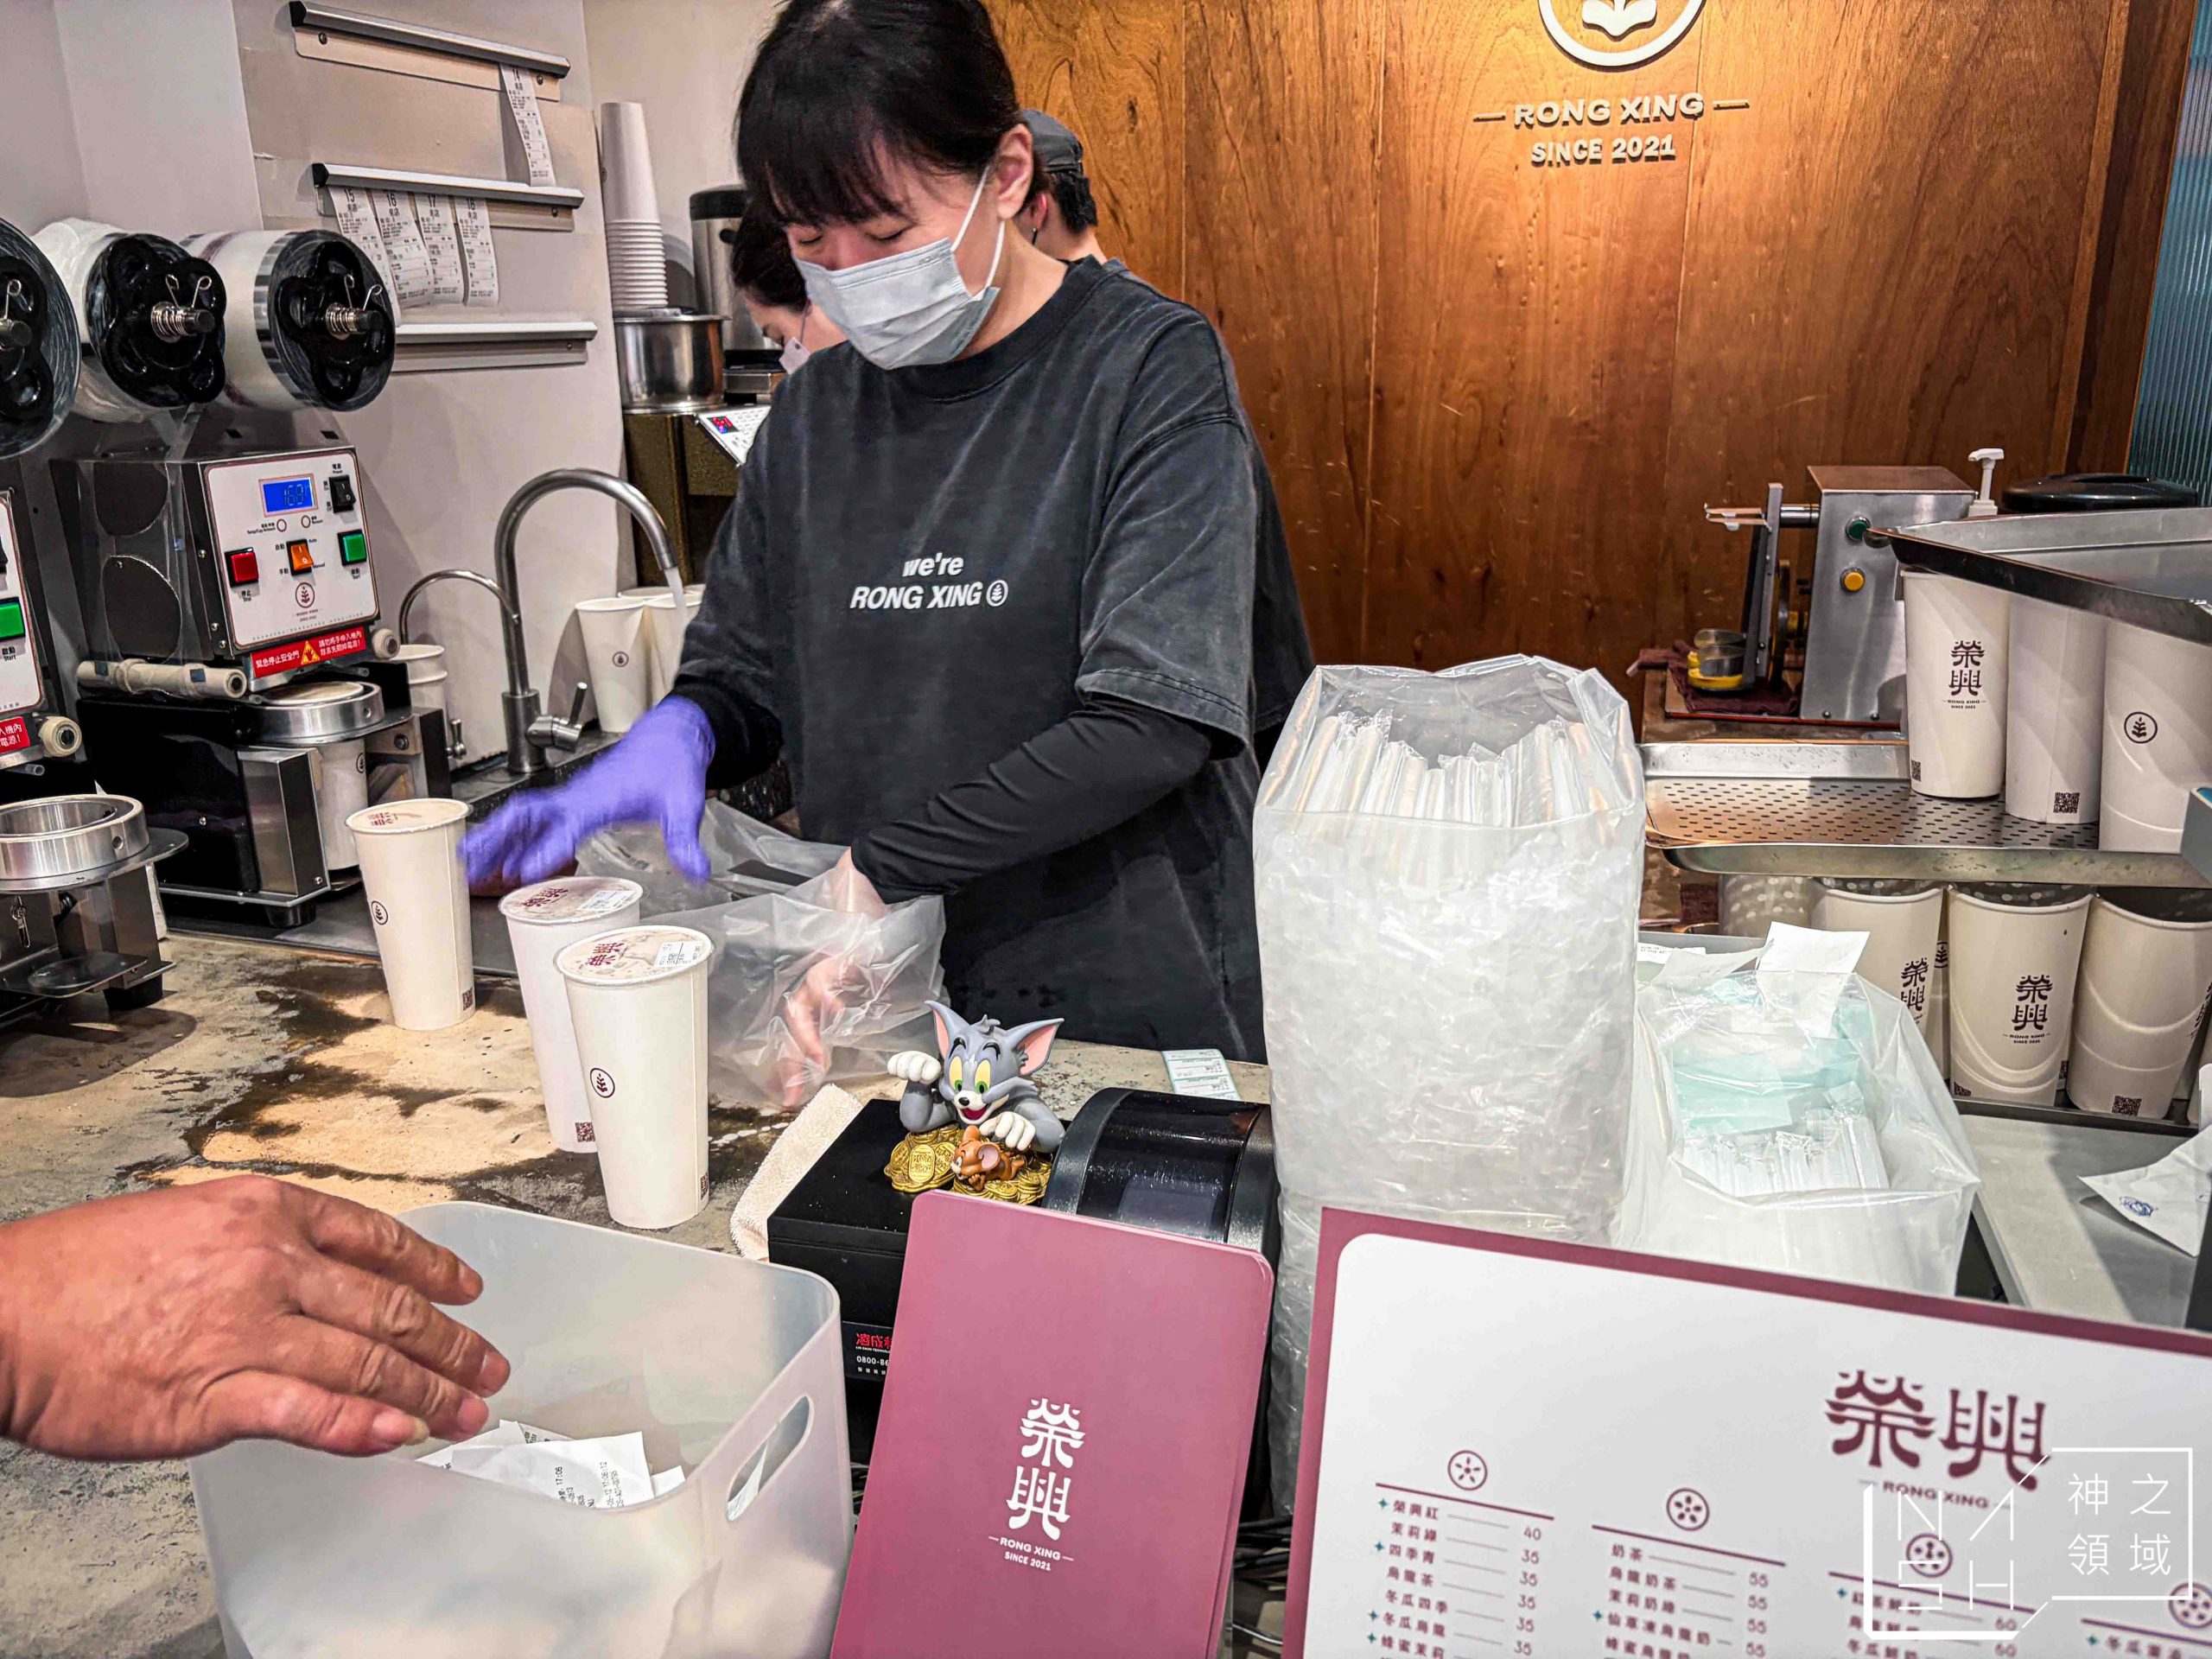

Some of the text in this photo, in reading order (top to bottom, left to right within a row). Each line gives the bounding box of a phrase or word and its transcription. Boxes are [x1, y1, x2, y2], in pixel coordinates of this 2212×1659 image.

[1515, 92, 1704, 127] RONG XING
[1531, 134, 1675, 166] SINCE 2021
[902, 553, 963, 576] we're
[850, 582, 983, 609] RONG XING
[1948, 640, 1985, 696] 榮興
[2012, 975, 2053, 1031] 榮興
[1825, 1370, 2051, 1492] 榮興
[1006, 1398, 1085, 1541] 榮興
[1883, 1481, 1989, 1510] RONG XING
[1394, 1500, 1541, 1541] 榮興紅 40
[1000, 1536, 1061, 1560] RONG XING
[1392, 1522, 1540, 1564] 茉莉綠 35
[1004, 1551, 1052, 1571] SINCE 2021
[1389, 1544, 1538, 1586] 四季青 35
[1612, 1544, 1769, 1587] 奶茶 55
[1386, 1590, 1535, 1632] 冬瓜四季 35
[1517, 1595, 1536, 1610] 35
[1748, 1595, 1768, 1610] 55
[1746, 1618, 1766, 1634] 55
[1514, 1641, 1532, 1656] 35
[1745, 1643, 1765, 1657] 55
